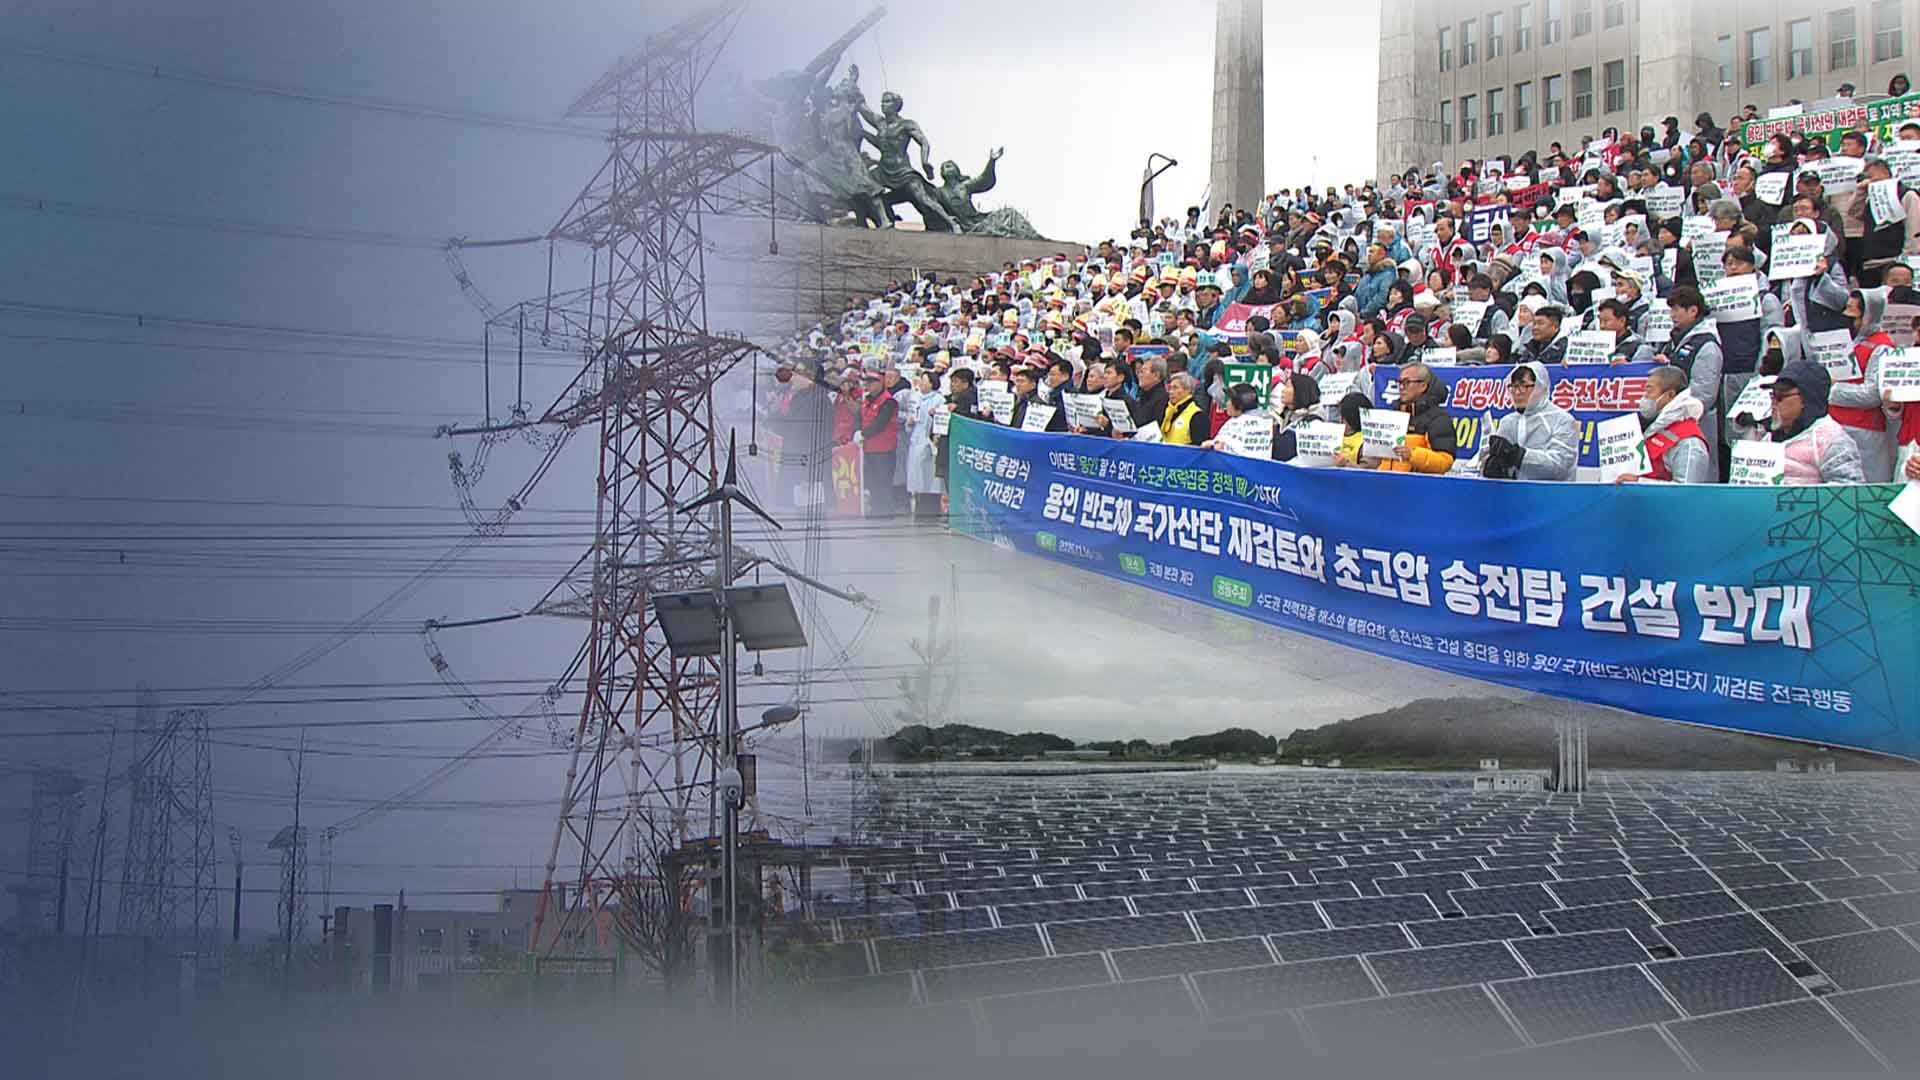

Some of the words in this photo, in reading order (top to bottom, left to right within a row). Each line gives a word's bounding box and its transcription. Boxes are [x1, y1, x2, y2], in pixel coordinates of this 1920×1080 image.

[1552, 377, 1650, 411] 송전선로
[957, 444, 996, 473] 전국행동
[995, 454, 1031, 482] 출범식
[1049, 451, 1077, 471] 이대로
[1138, 464, 1166, 488] 수도권
[1212, 471, 1234, 497] 정책
[983, 479, 1026, 510] 기자회견
[1042, 482, 1079, 524] 용인
[1079, 490, 1133, 537] 반도체
[1134, 501, 1224, 556] 국가산단
[1227, 515, 1328, 585] 재검토와
[1333, 542, 1432, 608] 초고압
[1440, 559, 1567, 629] 송전탑
[1580, 574, 1681, 640] 건설
[1692, 583, 1813, 650] 반대
[1256, 593, 1281, 613] 수도권
[1317, 609, 1346, 630] 해소와
[1388, 629, 1435, 650] 송전선로
[1437, 636, 1460, 657] 건설
[1463, 640, 1499, 664] 중단을
[1503, 648, 1530, 669] 위한
[1531, 653, 1563, 673] 용인
[1712, 674, 1766, 702] 재검토
[1770, 683, 1852, 713] 전국행동
